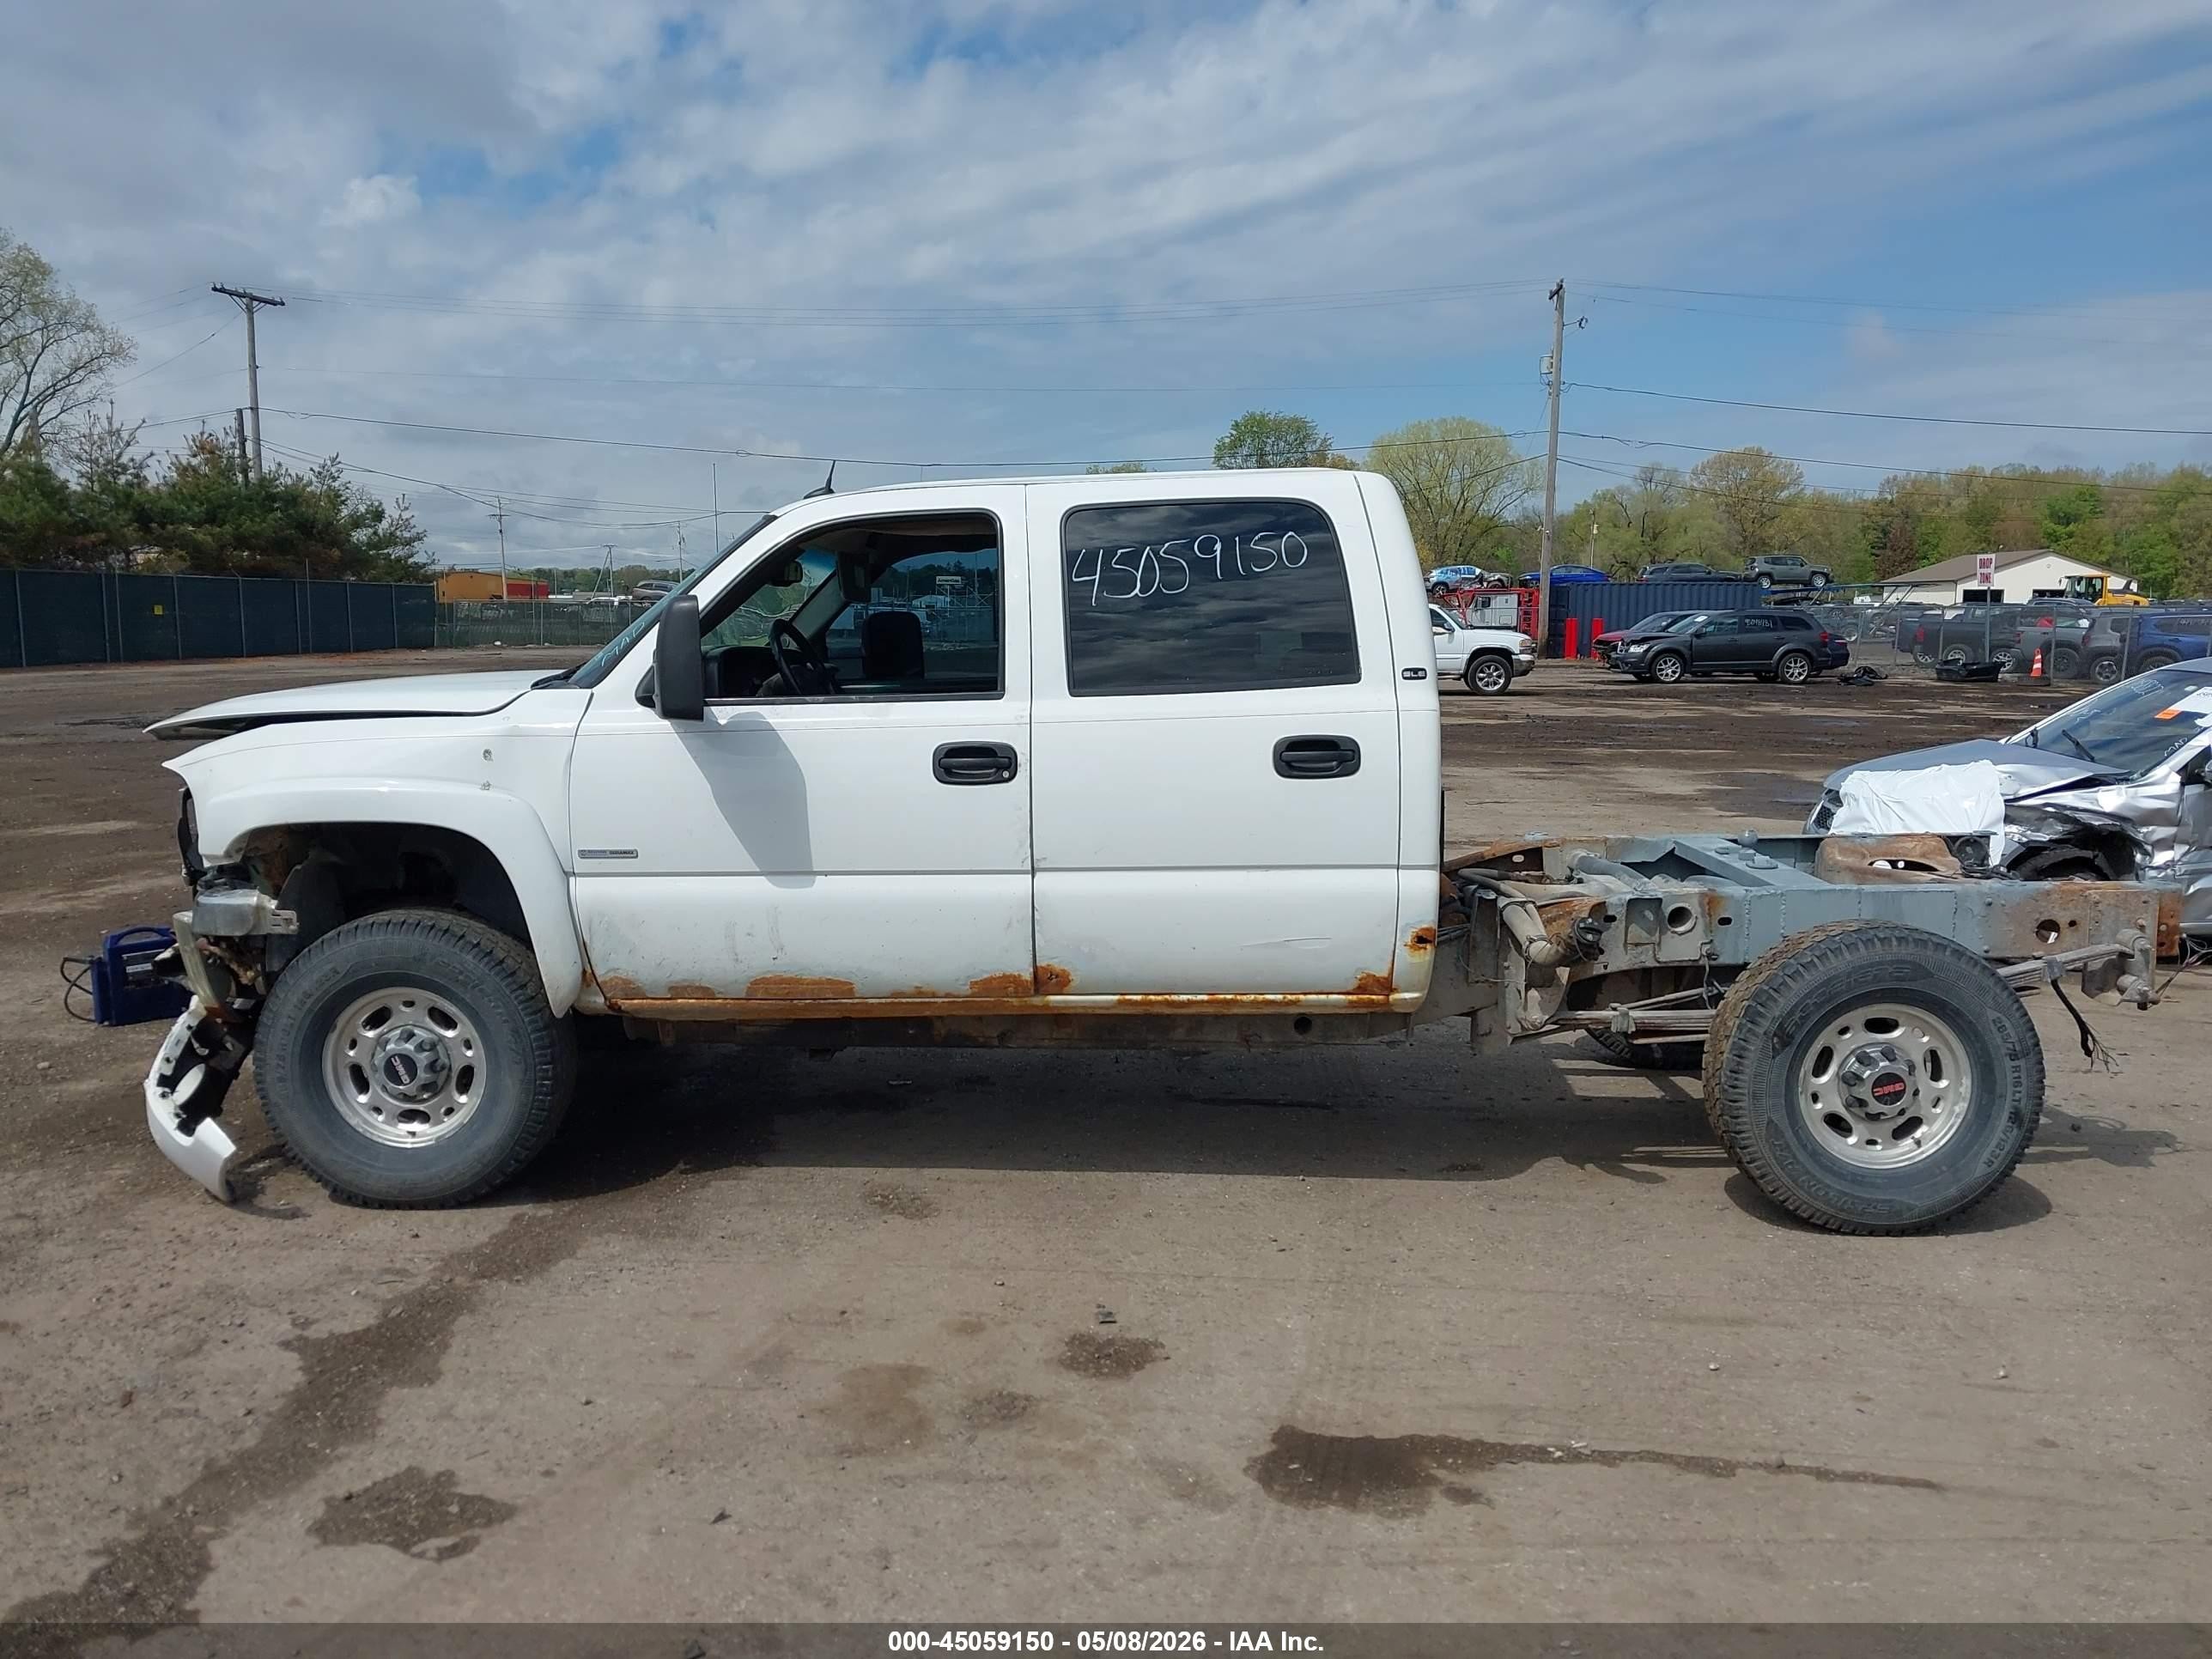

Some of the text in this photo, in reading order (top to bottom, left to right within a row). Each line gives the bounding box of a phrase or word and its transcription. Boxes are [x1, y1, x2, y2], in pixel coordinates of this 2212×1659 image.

[1072, 531, 1307, 606] 45059150
[1978, 558, 1993, 569] DROP
[1978, 572, 1992, 584] ZONE
[1990, 1014, 2020, 1062] 285/75
[1872, 1081, 1905, 1097] GMC
